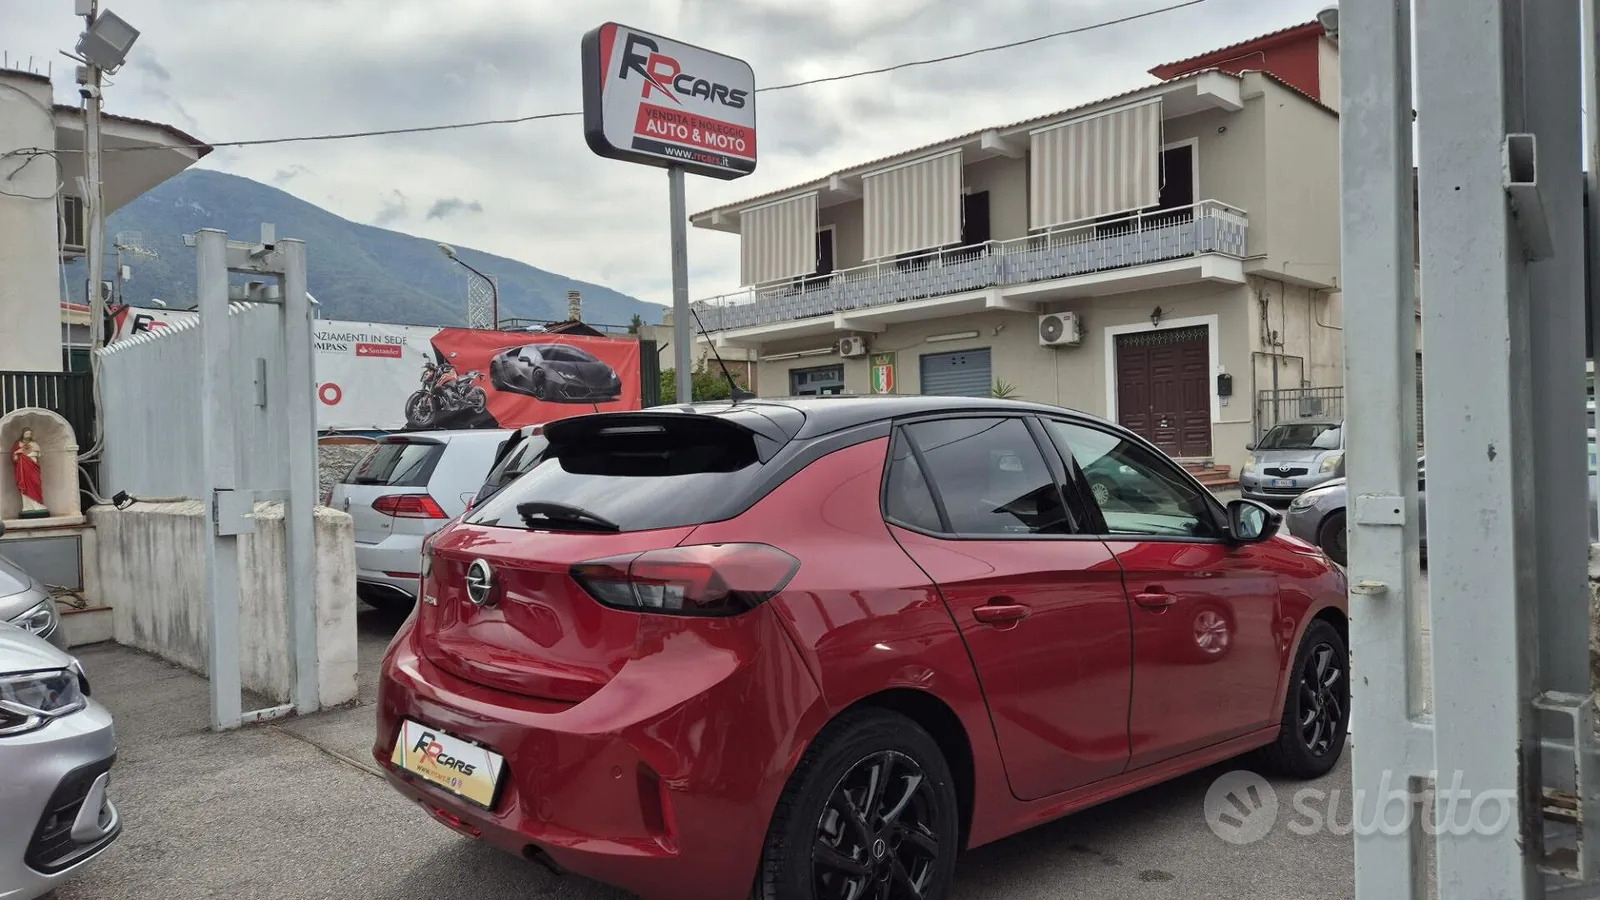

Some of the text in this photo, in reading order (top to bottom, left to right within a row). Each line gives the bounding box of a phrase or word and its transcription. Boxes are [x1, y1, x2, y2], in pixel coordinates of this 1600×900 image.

[645, 107, 745, 138] VENDITA E NOLEGGIO
[646, 118, 746, 152] AUTO & MOTO
[664, 146, 729, 167] www.rrcars.it
[368, 347, 400, 355] Santander
[371, 335, 381, 343] IN
[384, 335, 408, 346] SEDE
[315, 382, 342, 406] O
